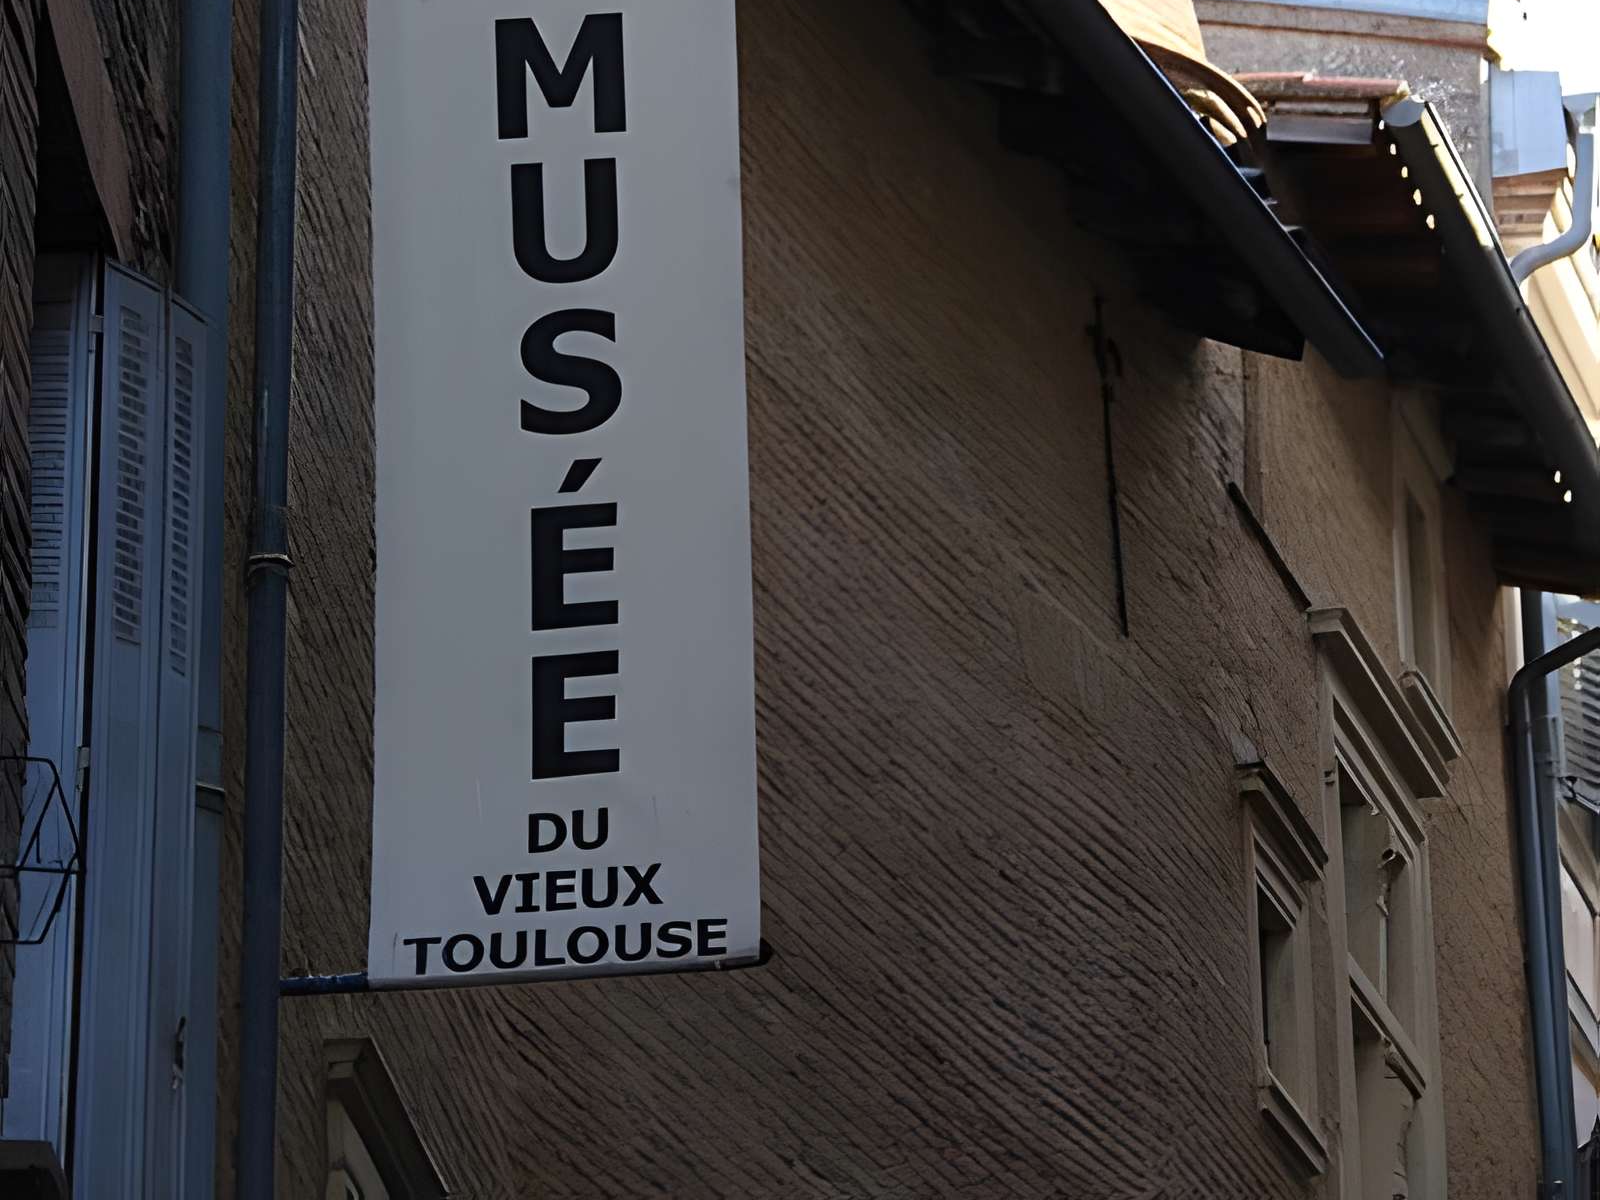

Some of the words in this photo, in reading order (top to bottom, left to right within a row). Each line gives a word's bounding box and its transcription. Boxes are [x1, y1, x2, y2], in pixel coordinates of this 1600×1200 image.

[494, 11, 627, 780] MUSÉE
[528, 807, 609, 854] DU
[473, 862, 664, 916] VIEUX
[403, 918, 728, 976] TOULOUSE
